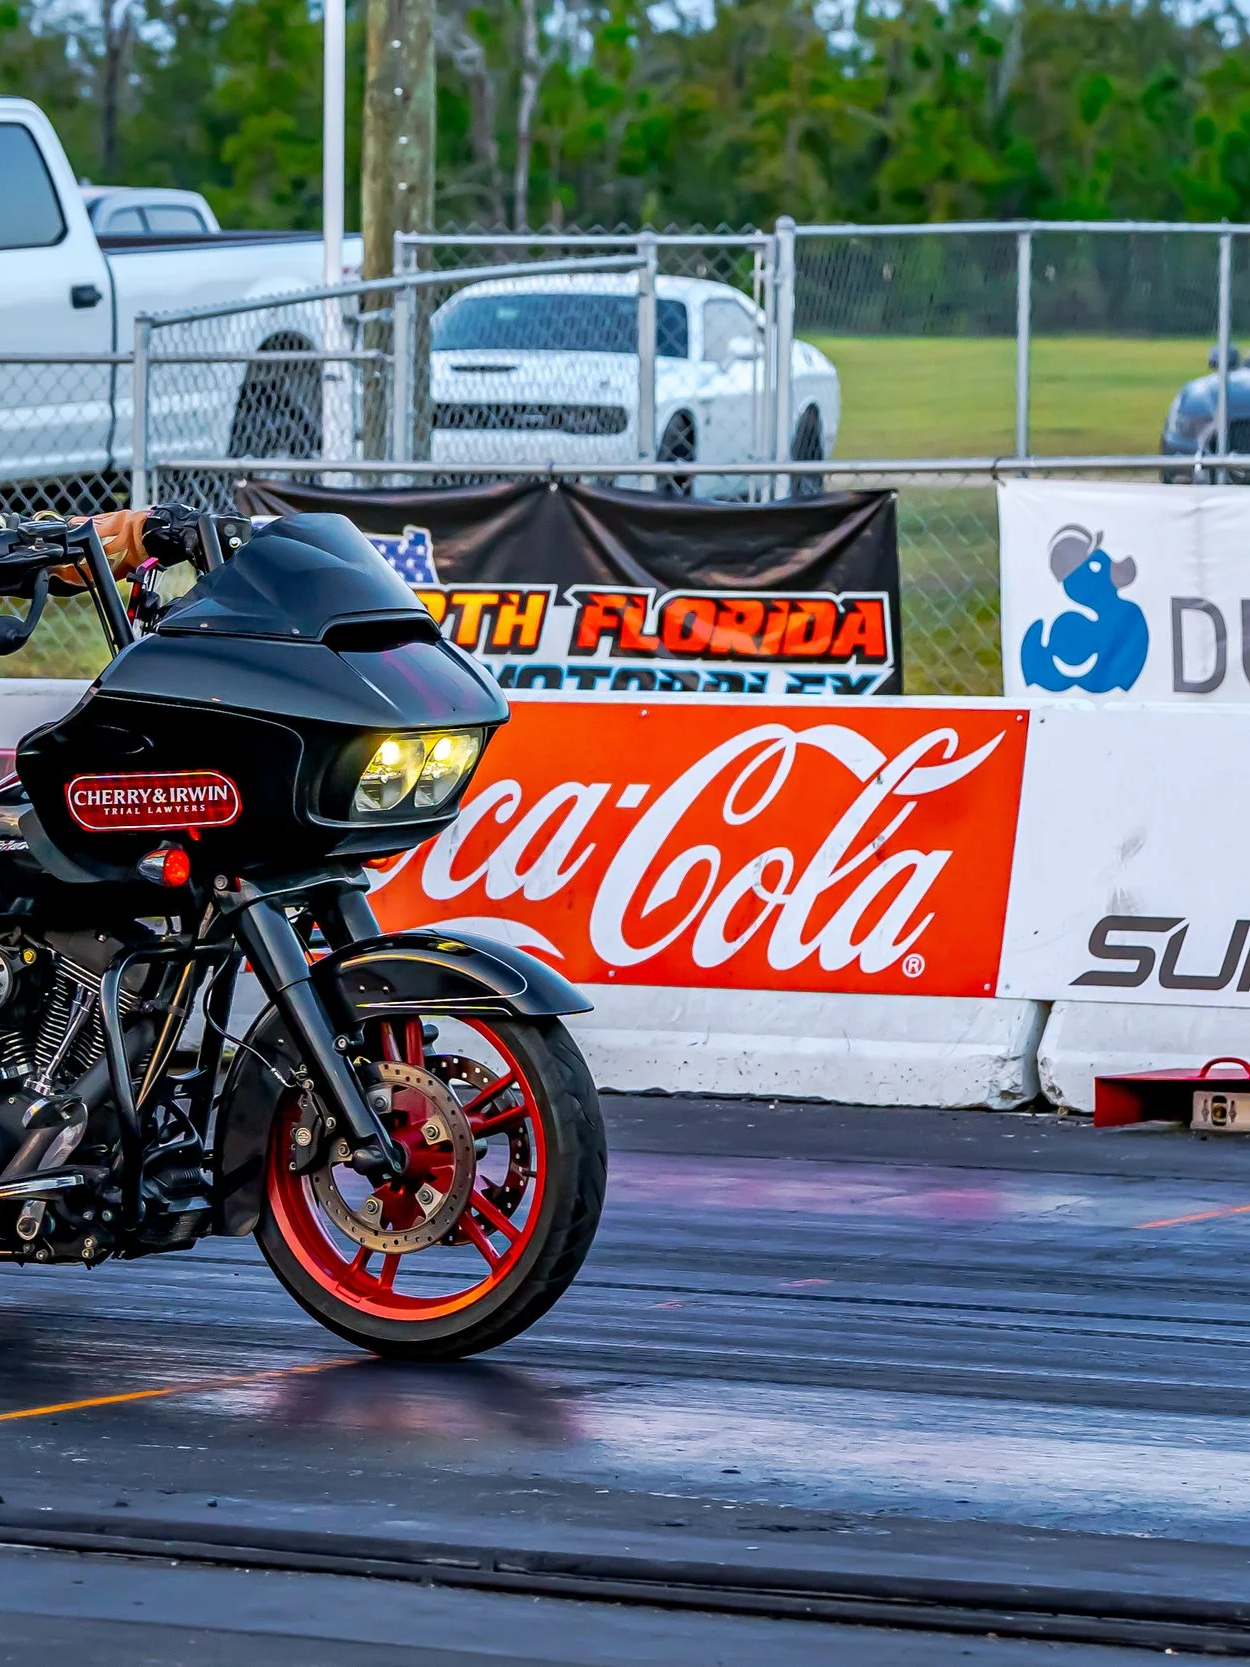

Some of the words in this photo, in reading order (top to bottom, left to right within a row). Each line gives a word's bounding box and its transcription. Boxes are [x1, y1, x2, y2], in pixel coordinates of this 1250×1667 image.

[573, 592, 888, 659] FLORIDA
[1171, 597, 1250, 694] D
[103, 807, 141, 816] TRIAL
[147, 804, 206, 815] LAWYERS
[361, 723, 1006, 974] ca-Cola
[1068, 914, 1250, 992] SU
